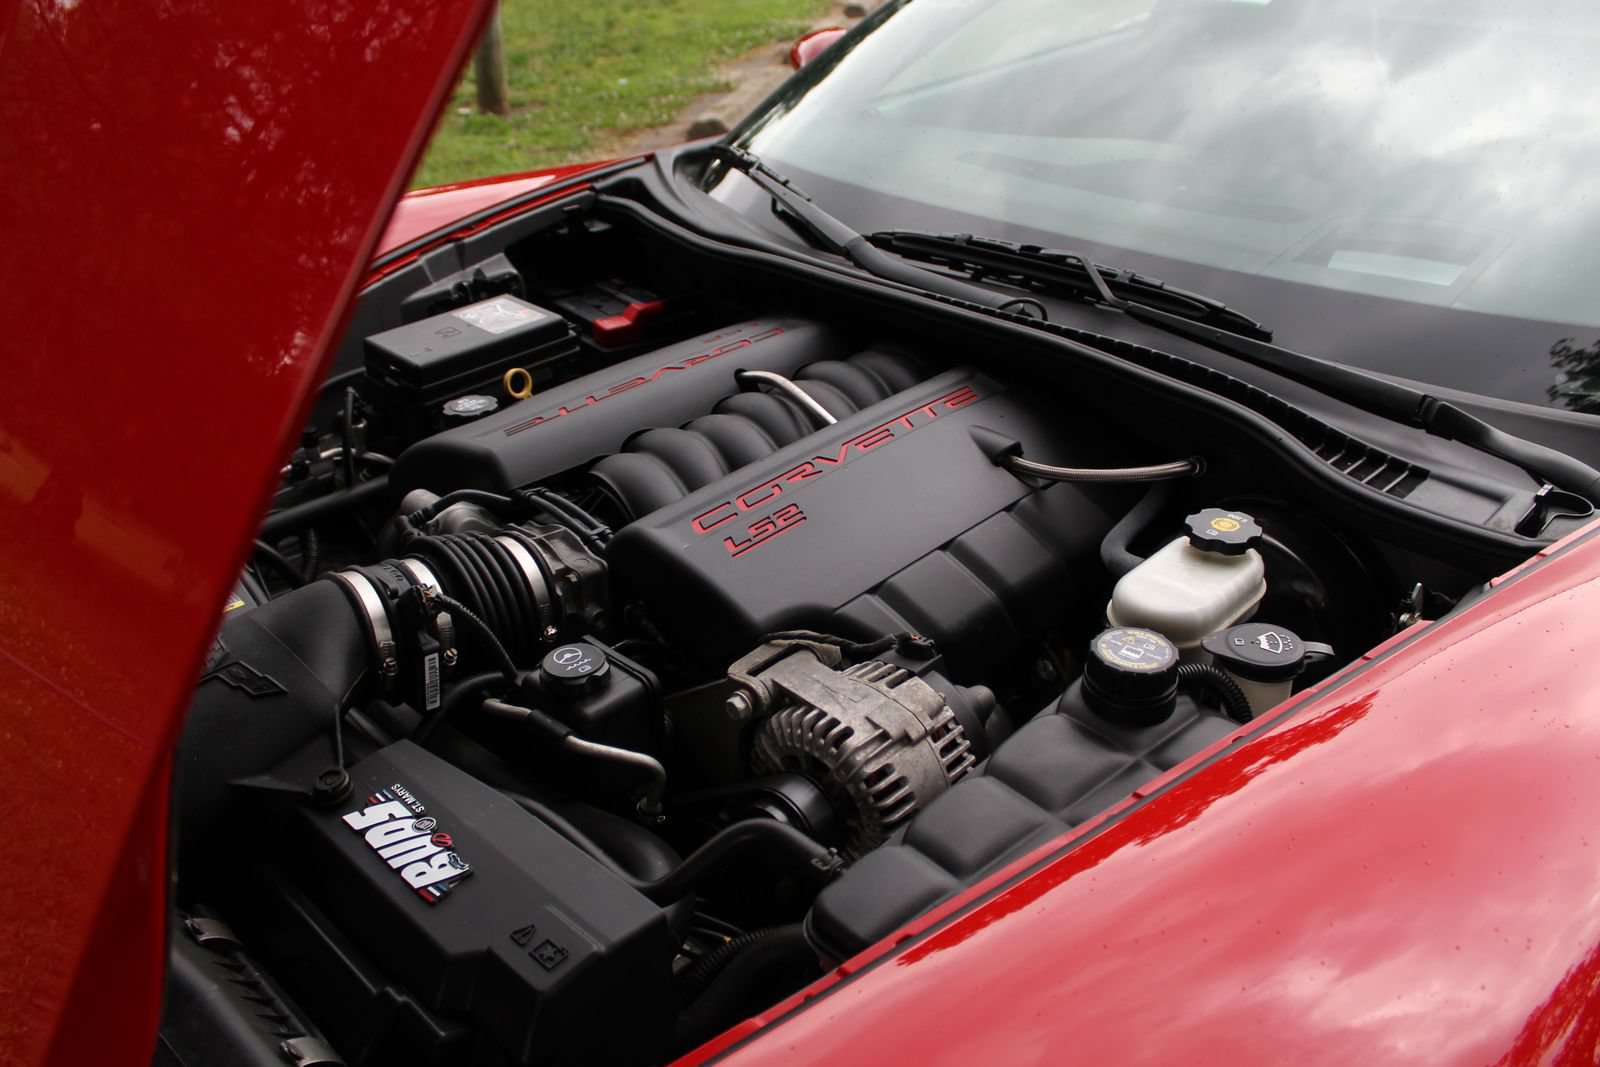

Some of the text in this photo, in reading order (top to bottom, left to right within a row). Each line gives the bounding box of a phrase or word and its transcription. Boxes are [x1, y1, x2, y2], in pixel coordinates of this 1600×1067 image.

[504, 327, 784, 437] CORVETTE
[691, 385, 978, 534] CORVETTE
[723, 503, 807, 557] LS2
[391, 783, 425, 813] ST. MARYS
[342, 801, 470, 889] BUDS
